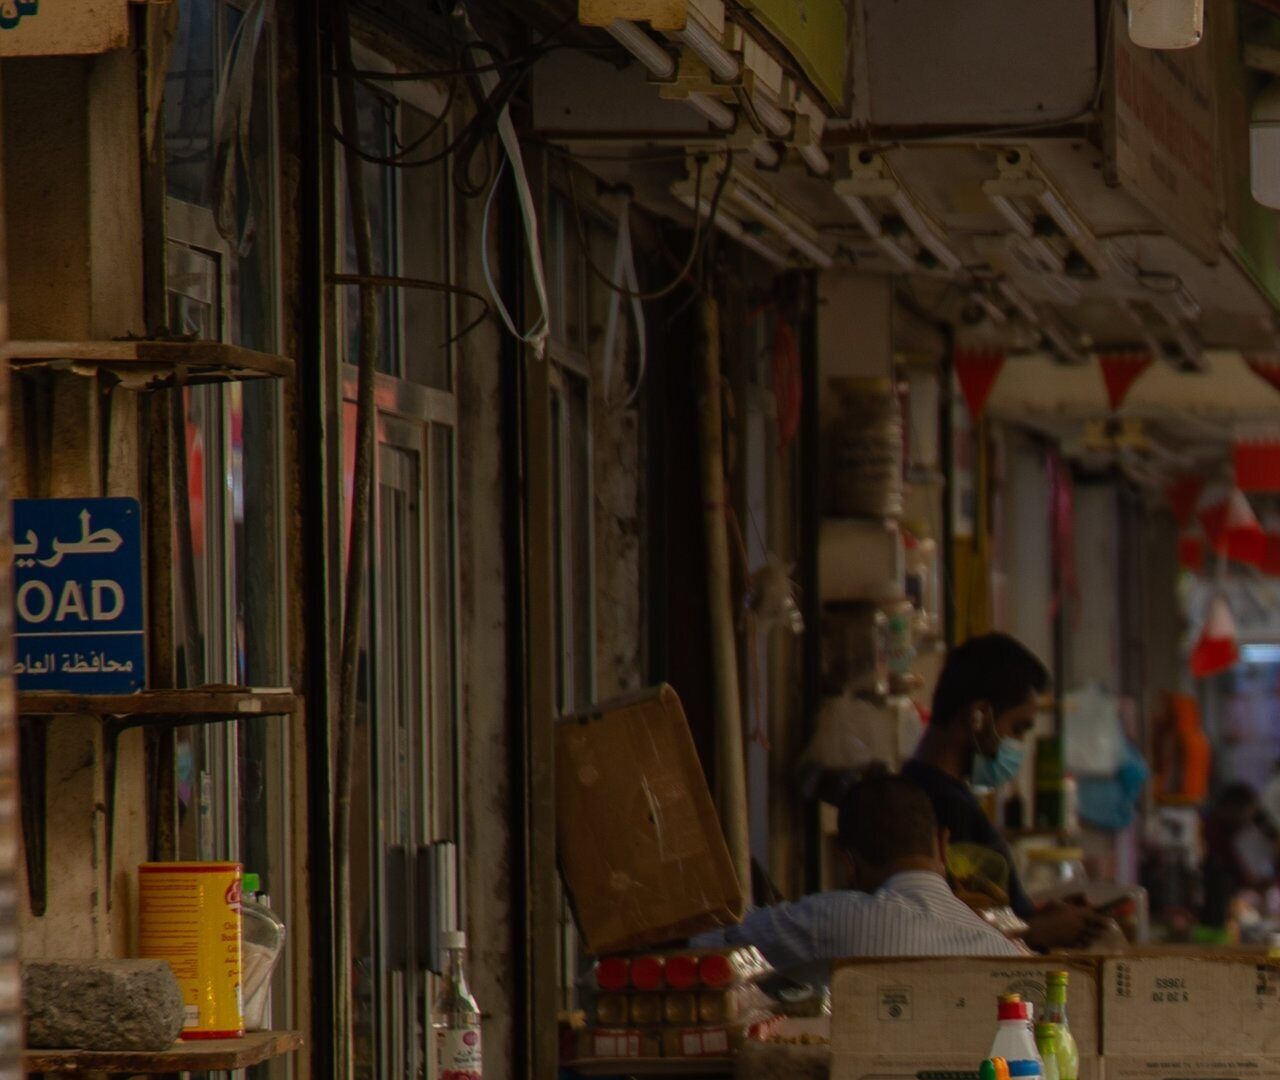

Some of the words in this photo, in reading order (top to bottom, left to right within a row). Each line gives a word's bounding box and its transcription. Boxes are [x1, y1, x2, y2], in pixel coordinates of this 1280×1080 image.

[13, 508, 124, 568] طري
[16, 579, 125, 623] OAD
[13, 651, 56, 674] العاص
[61, 650, 134, 674] محافظة
